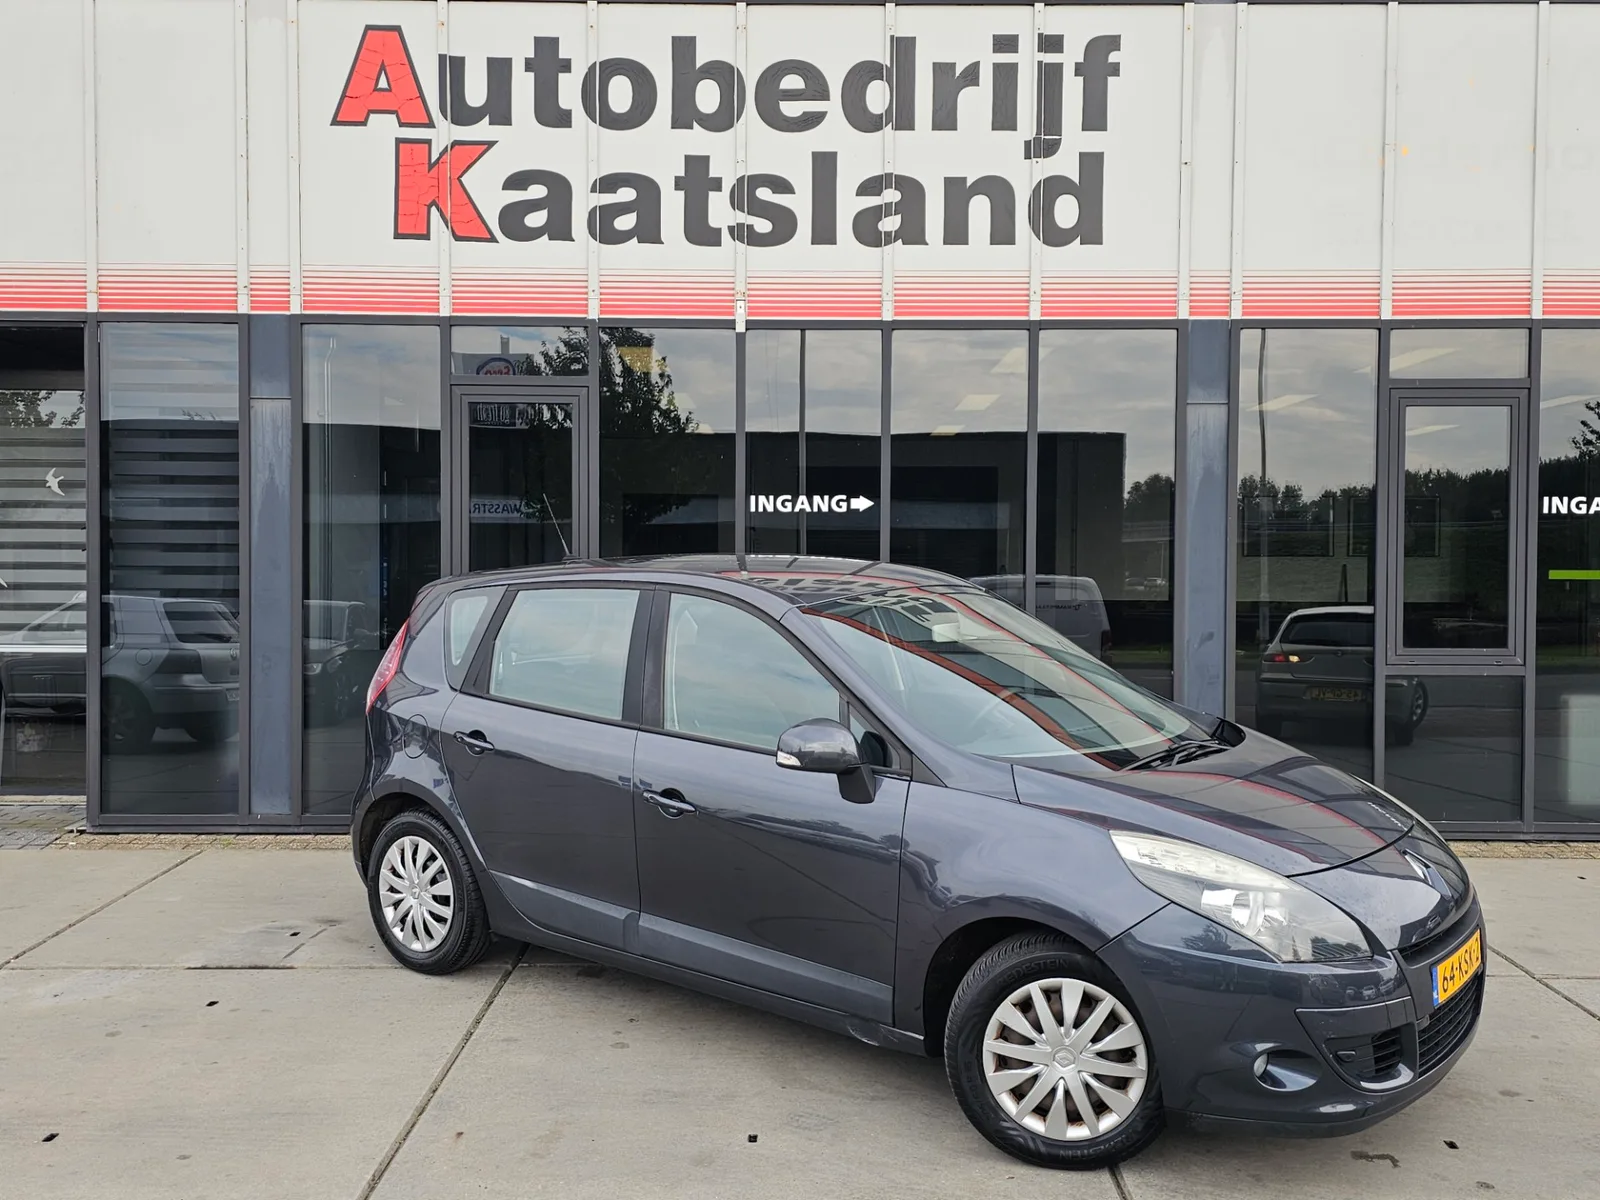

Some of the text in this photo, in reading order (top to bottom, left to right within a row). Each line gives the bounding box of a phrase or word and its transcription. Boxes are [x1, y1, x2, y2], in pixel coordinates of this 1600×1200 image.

[329, 24, 1121, 160] Autobedrijf
[393, 137, 1105, 248] Kaatsland
[749, 495, 848, 513] INGANG
